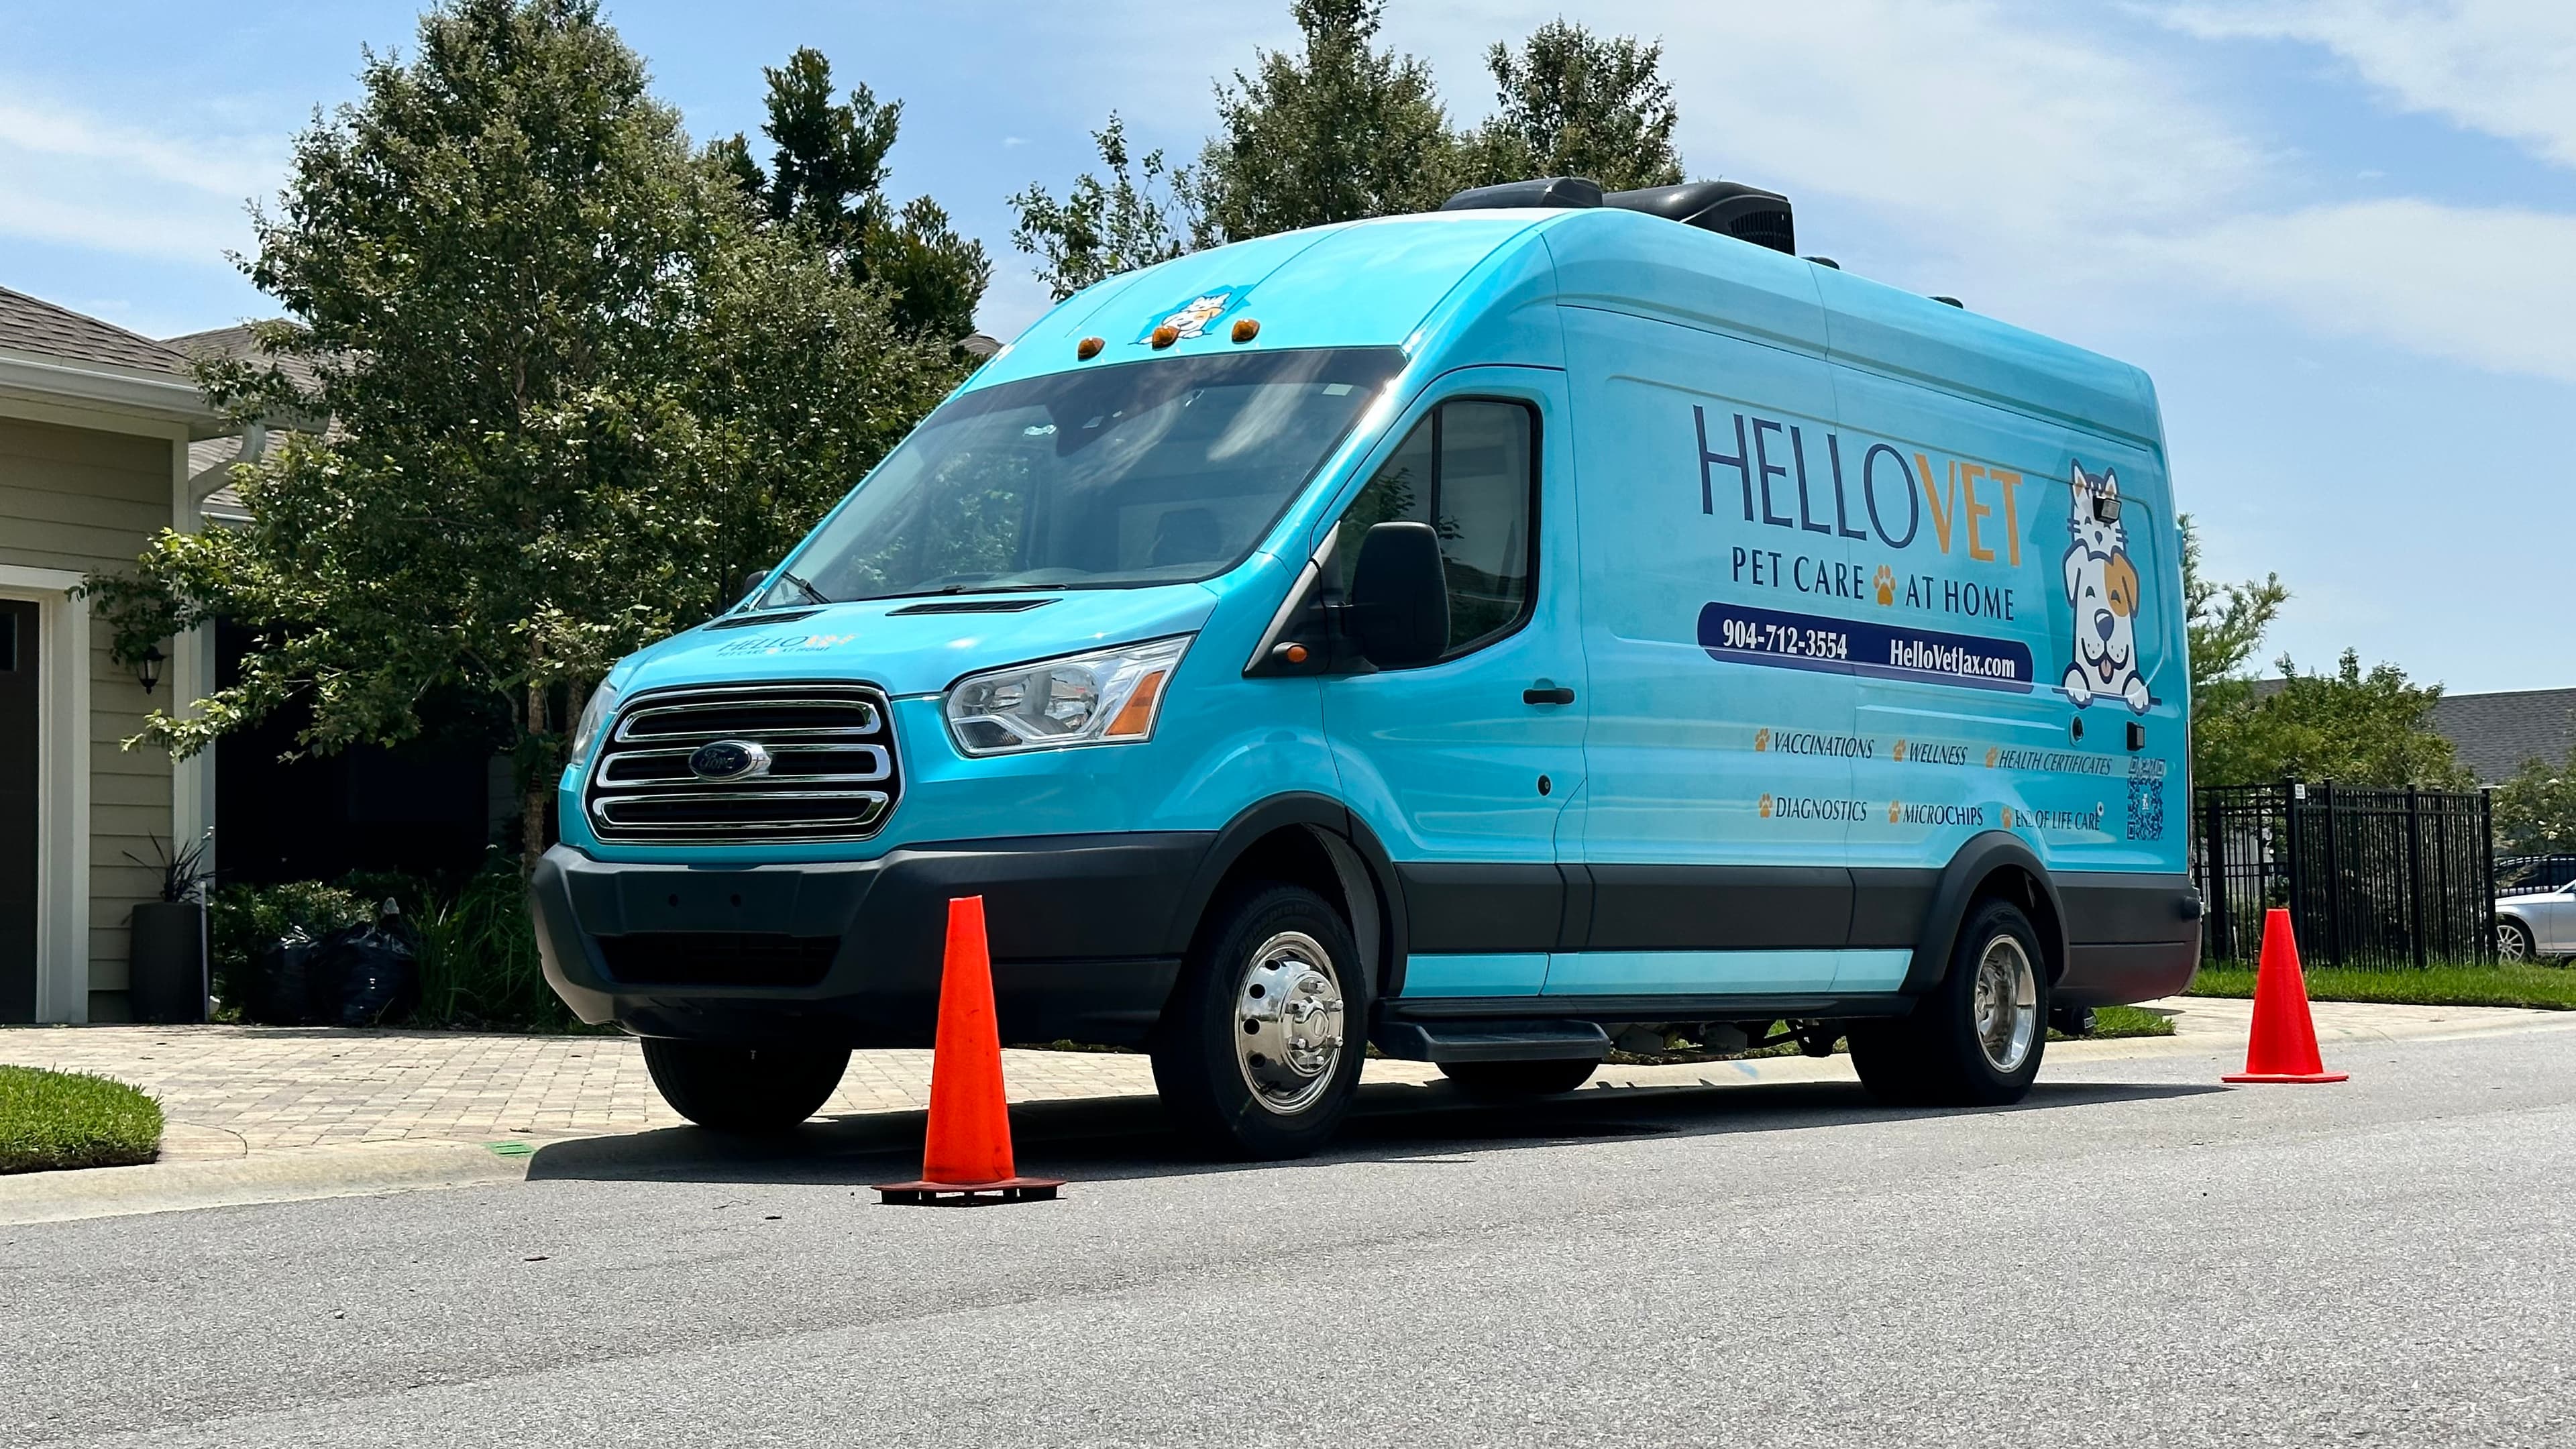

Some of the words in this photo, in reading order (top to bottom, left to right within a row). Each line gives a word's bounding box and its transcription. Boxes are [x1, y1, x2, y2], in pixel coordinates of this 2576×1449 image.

[1693, 405, 2023, 567] HELLOVET
[1731, 546, 1782, 588] PET
[1794, 556, 1864, 600] CARE
[1905, 574, 1934, 610] AT
[1945, 580, 2014, 621] HOME
[717, 634, 857, 652] HELLO
[1723, 619, 1847, 659] 904-712-3554
[1890, 639, 2015, 678] HelloVetJax.com
[1774, 732, 1874, 759] VACCINATIONS
[1909, 742, 1968, 765] WELLNESS
[1998, 750, 2043, 770] HEALTH
[2043, 753, 2112, 775] CERTIFICATES
[1776, 797, 1868, 821] DIAGNOSTICS
[1902, 804, 1984, 826] MICROCHIPS
[2015, 809, 2034, 827] END
[2035, 810, 2050, 828] OF
[2052, 810, 2072, 830] LIFE
[2075, 812, 2100, 830] CARE
